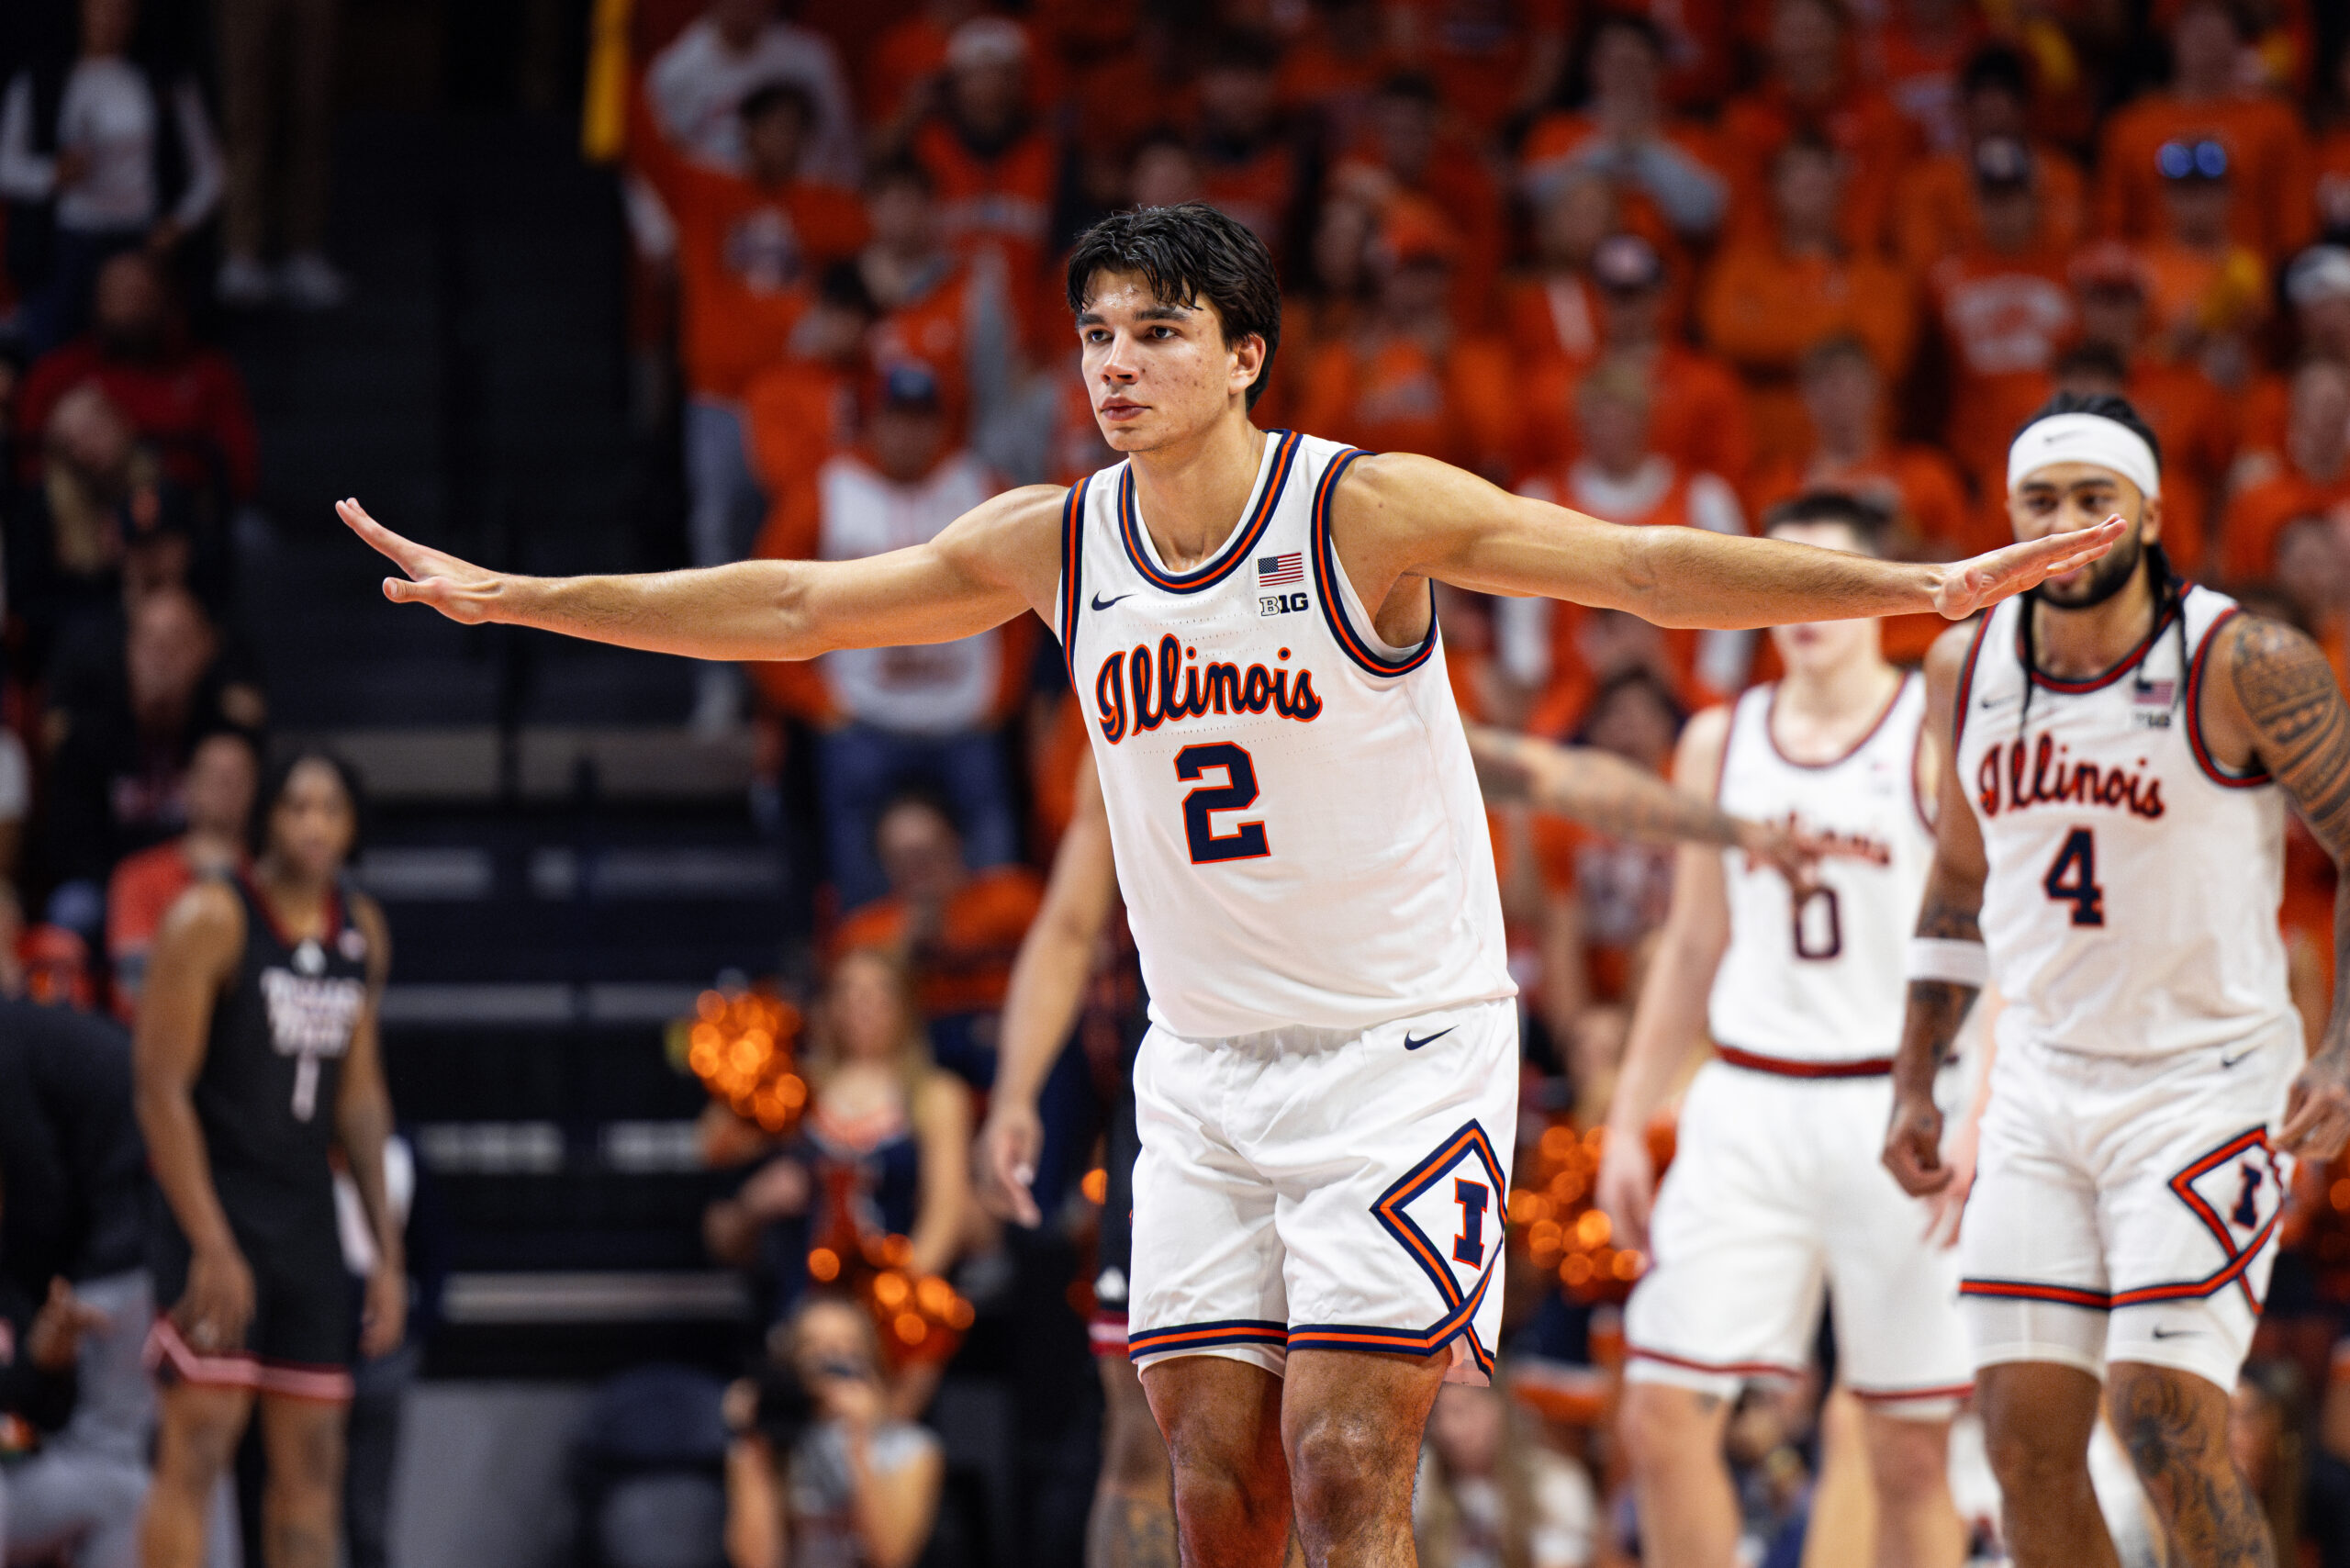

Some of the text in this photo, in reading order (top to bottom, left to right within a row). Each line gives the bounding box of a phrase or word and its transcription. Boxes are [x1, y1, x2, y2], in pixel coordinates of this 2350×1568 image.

[1095, 633, 1323, 745] Illinois
[1173, 741, 1270, 864] 2
[1979, 731, 2165, 818] Illinois
[1793, 884, 1841, 960] 0
[2042, 825, 2104, 927] 4
[1452, 1177, 1489, 1271] I
